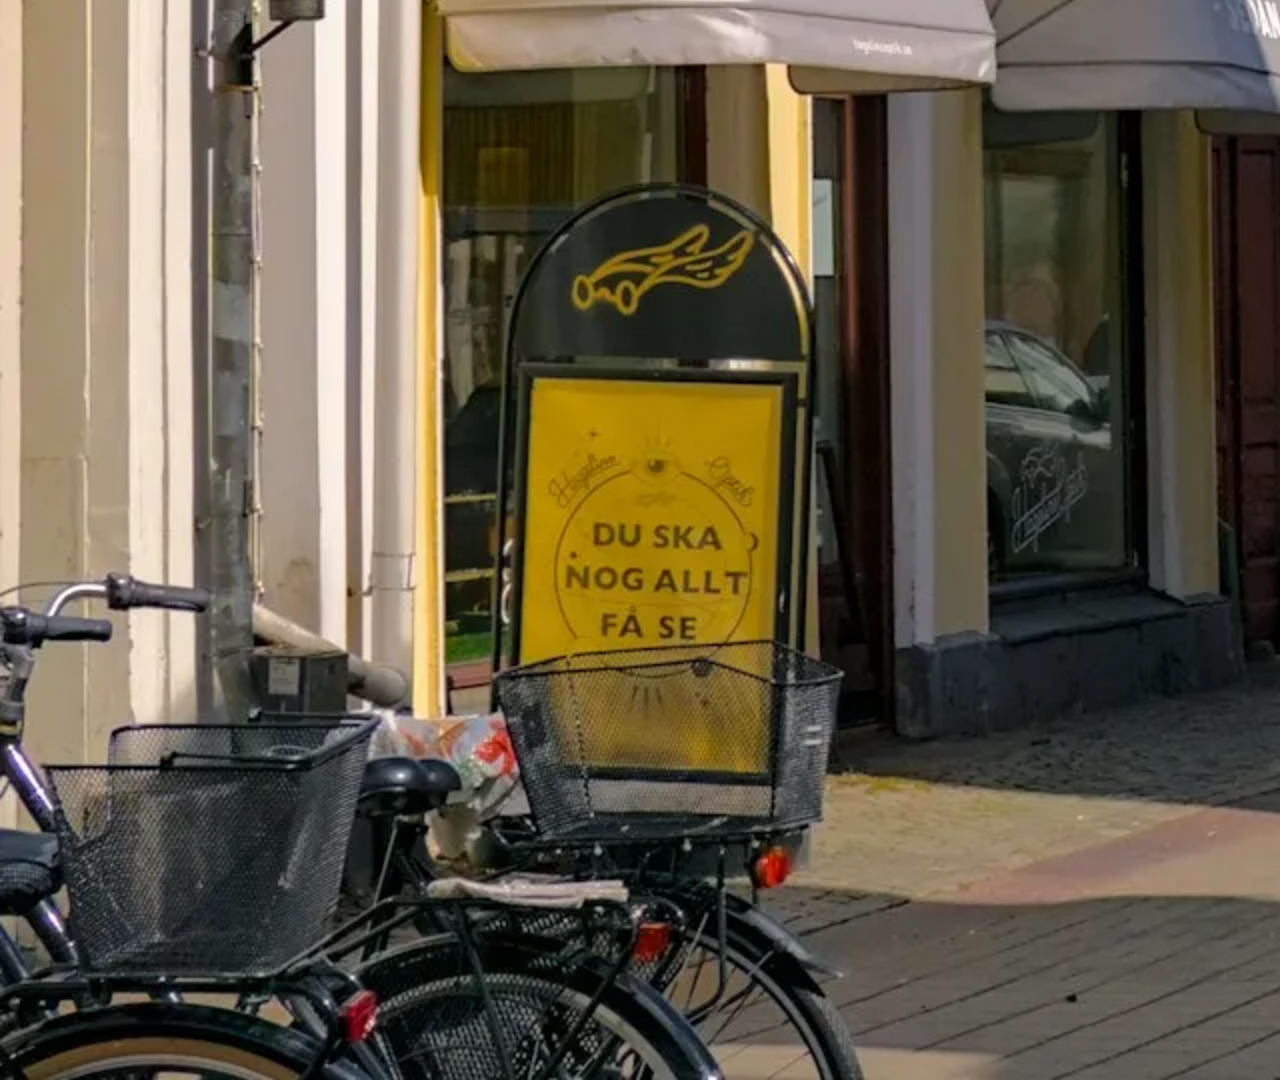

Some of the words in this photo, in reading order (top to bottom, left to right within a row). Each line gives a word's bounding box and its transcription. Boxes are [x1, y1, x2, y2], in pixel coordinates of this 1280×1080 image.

[592, 522, 641, 550] DU
[653, 524, 723, 552] SKA
[566, 564, 643, 592] NOG
[654, 568, 748, 596] ALLT
[600, 605, 644, 639] FÅ
[658, 614, 698, 641] SE
